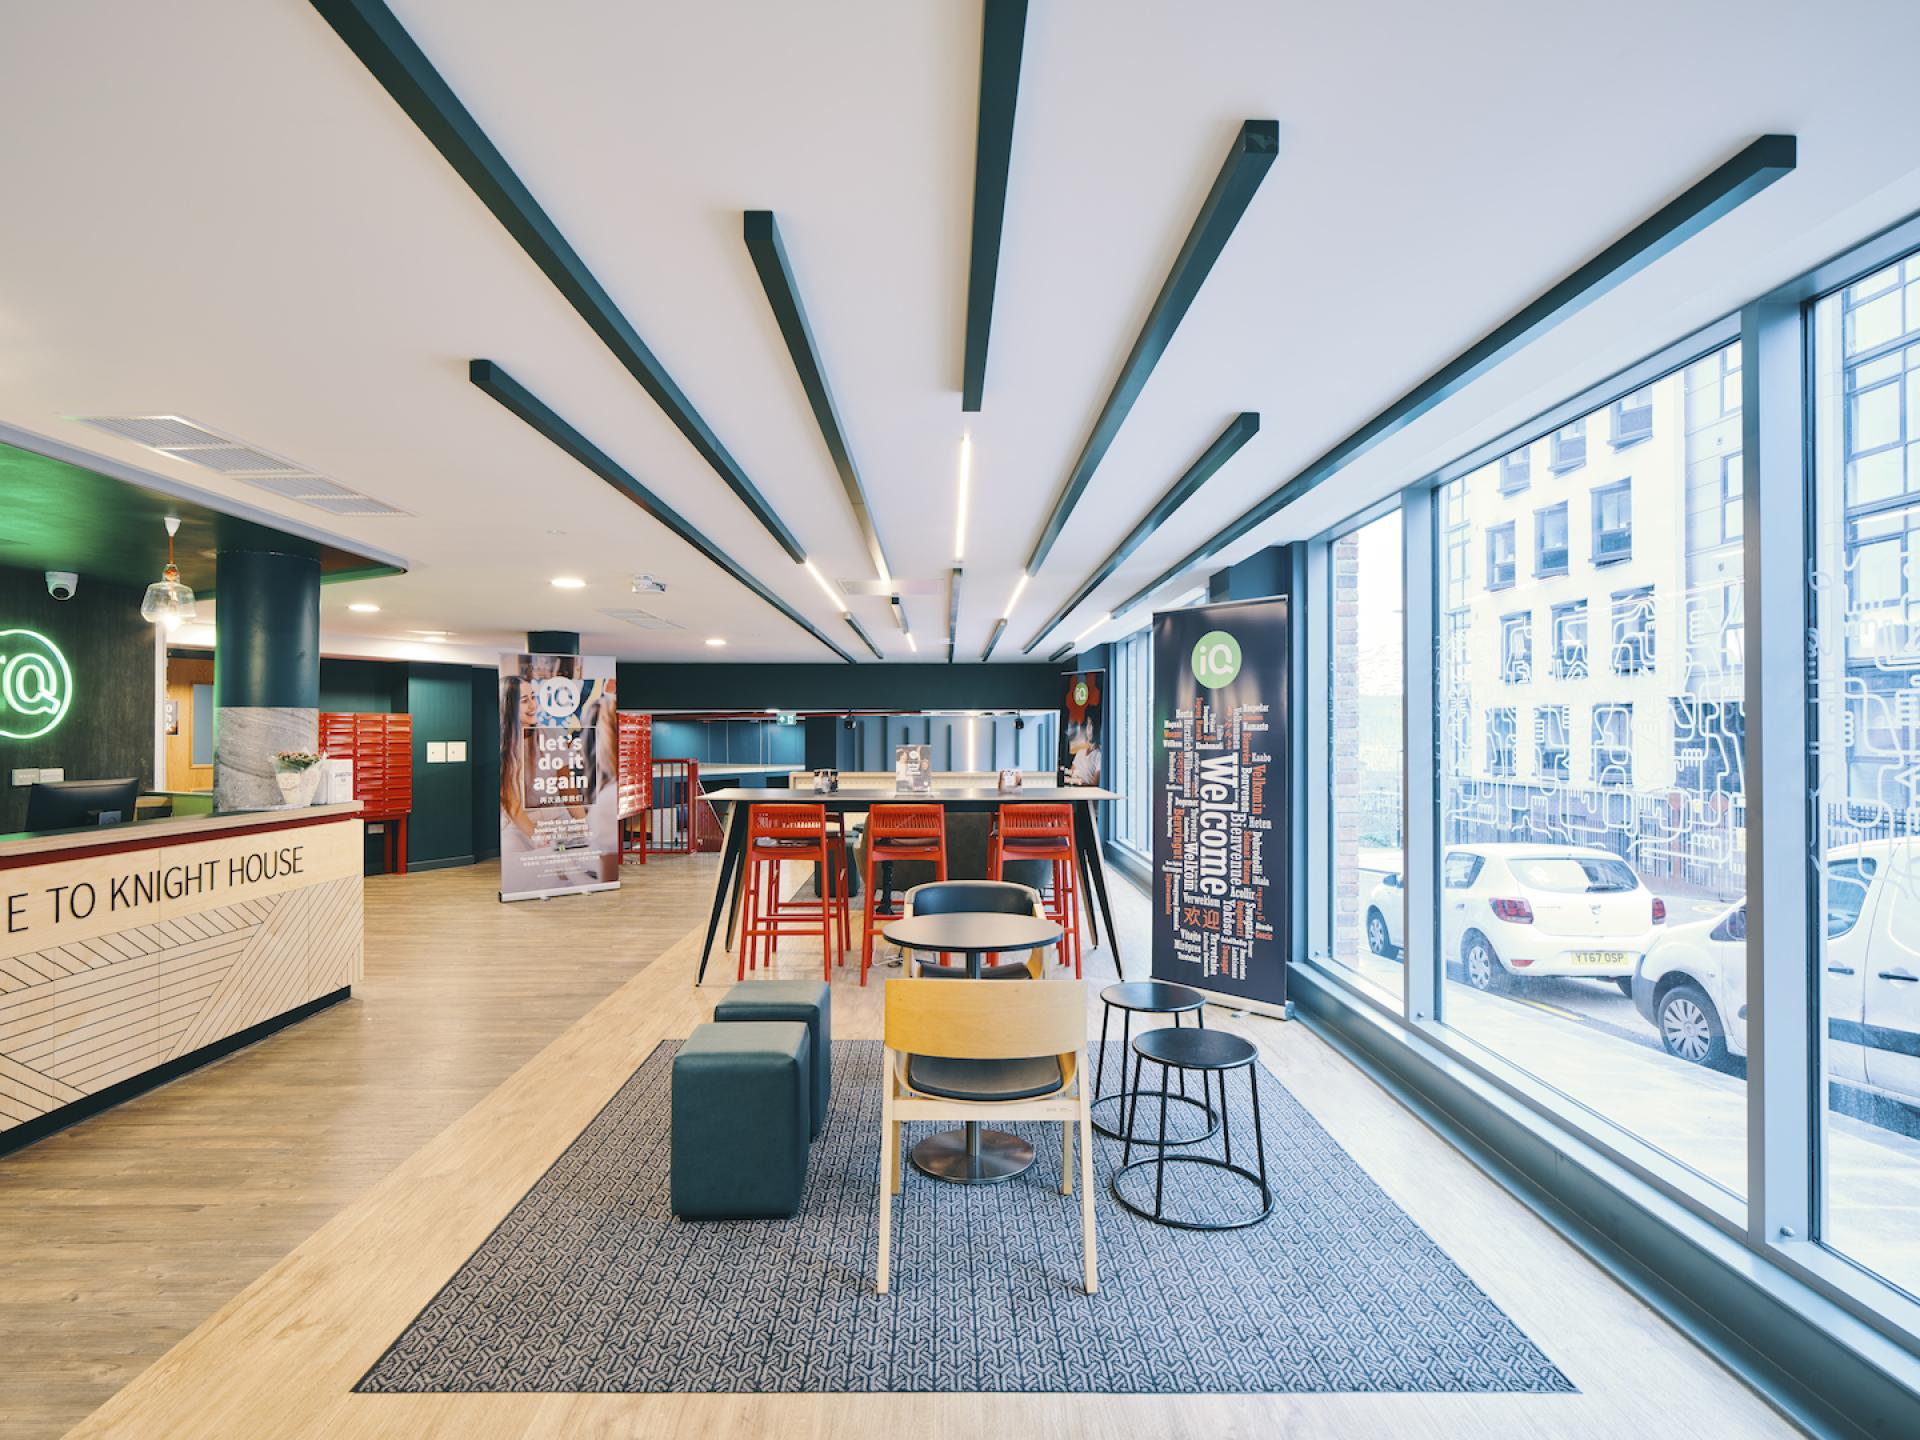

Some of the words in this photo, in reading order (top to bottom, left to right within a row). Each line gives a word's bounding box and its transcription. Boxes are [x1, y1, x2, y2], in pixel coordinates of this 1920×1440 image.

[1200, 643, 1234, 676] iQ
[546, 685, 574, 707] iQ
[539, 734, 583, 752] let's
[538, 754, 564, 770] do
[568, 754, 584, 769] it
[532, 772, 589, 795] again
[1200, 752, 1239, 896] Welcome
[1230, 812, 1247, 886] Bienvenue
[1183, 842, 1198, 891] Welkom
[45, 882, 96, 924] TO
[110, 859, 221, 912] KNIGHT
[228, 845, 304, 888] HOUSE
[1183, 905, 1221, 932] 欢迎
[1575, 952, 1602, 963] YT67
[1604, 952, 1624, 963] OSP
